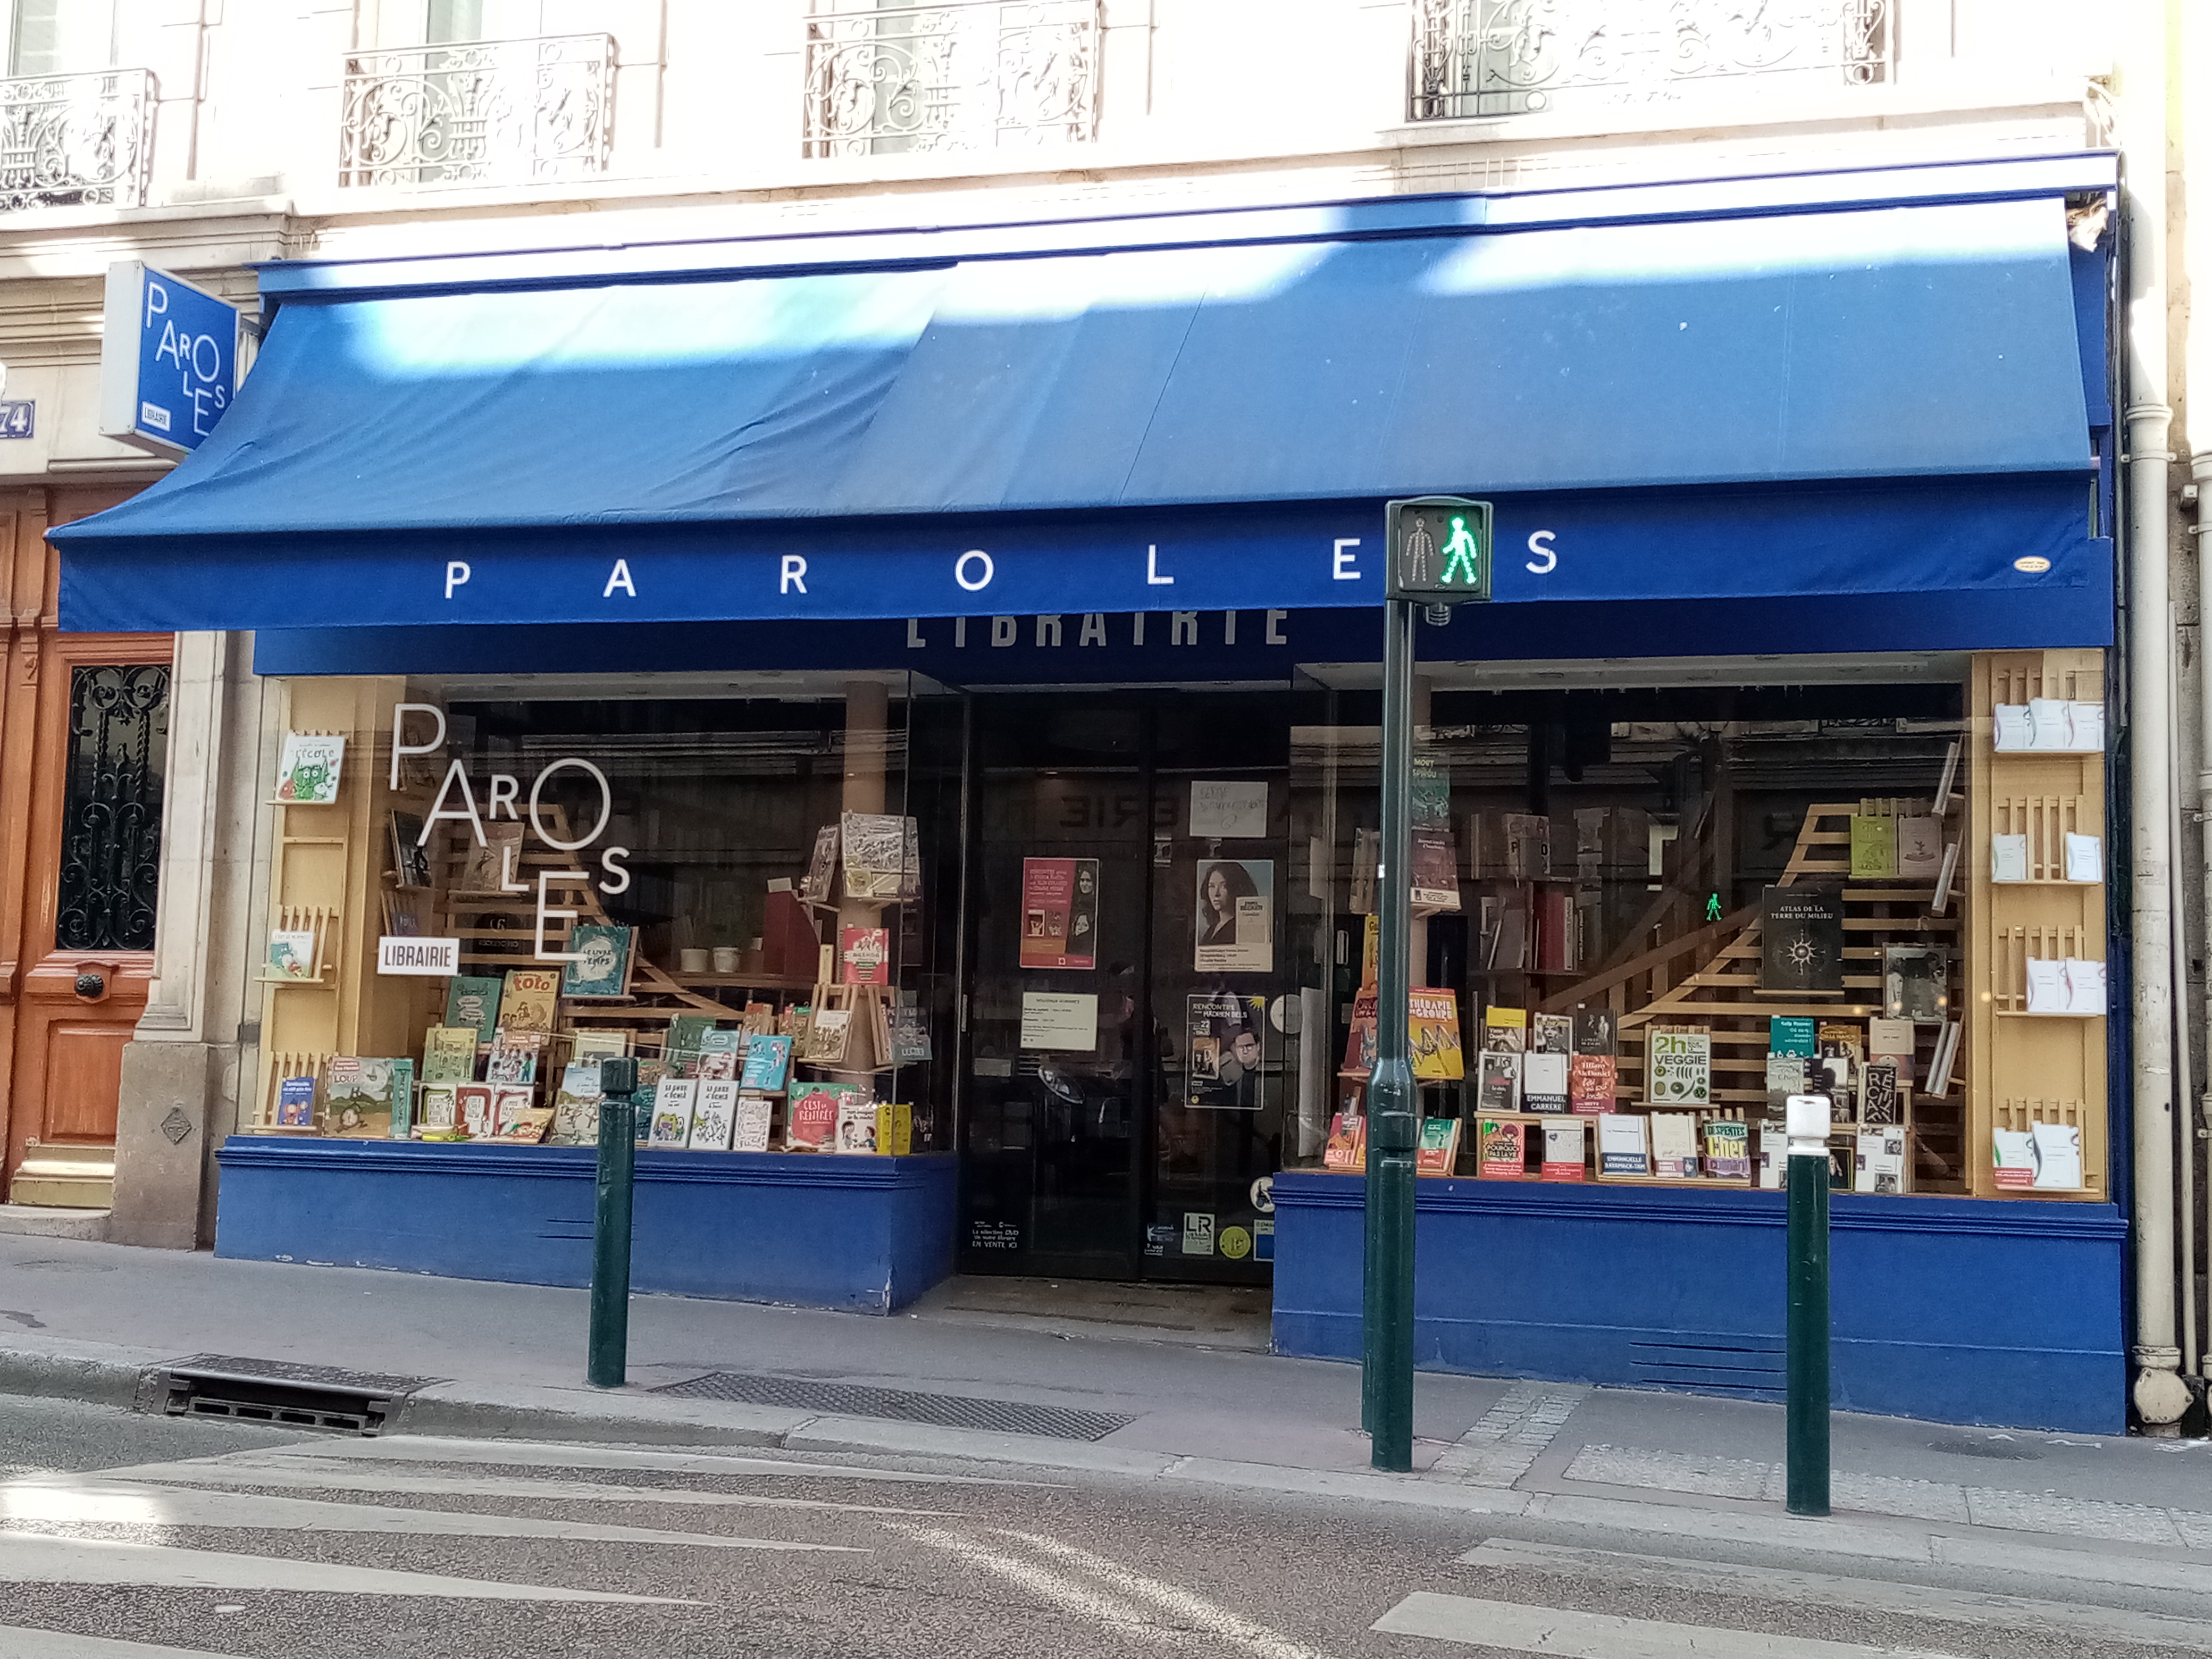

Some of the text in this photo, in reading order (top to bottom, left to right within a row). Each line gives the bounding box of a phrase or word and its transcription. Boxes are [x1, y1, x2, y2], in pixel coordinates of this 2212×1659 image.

[0, 406, 28, 432] 74
[384, 945, 451, 967] LIBRAIRIE
[513, 976, 550, 991] toto
[1416, 1009, 1453, 1020] GROUPE
[1654, 1036, 1686, 1054] 2h
[1654, 1055, 1707, 1065] VEGGIE
[334, 1075, 357, 1083] LOUP
[1708, 1136, 1746, 1159] Cher
